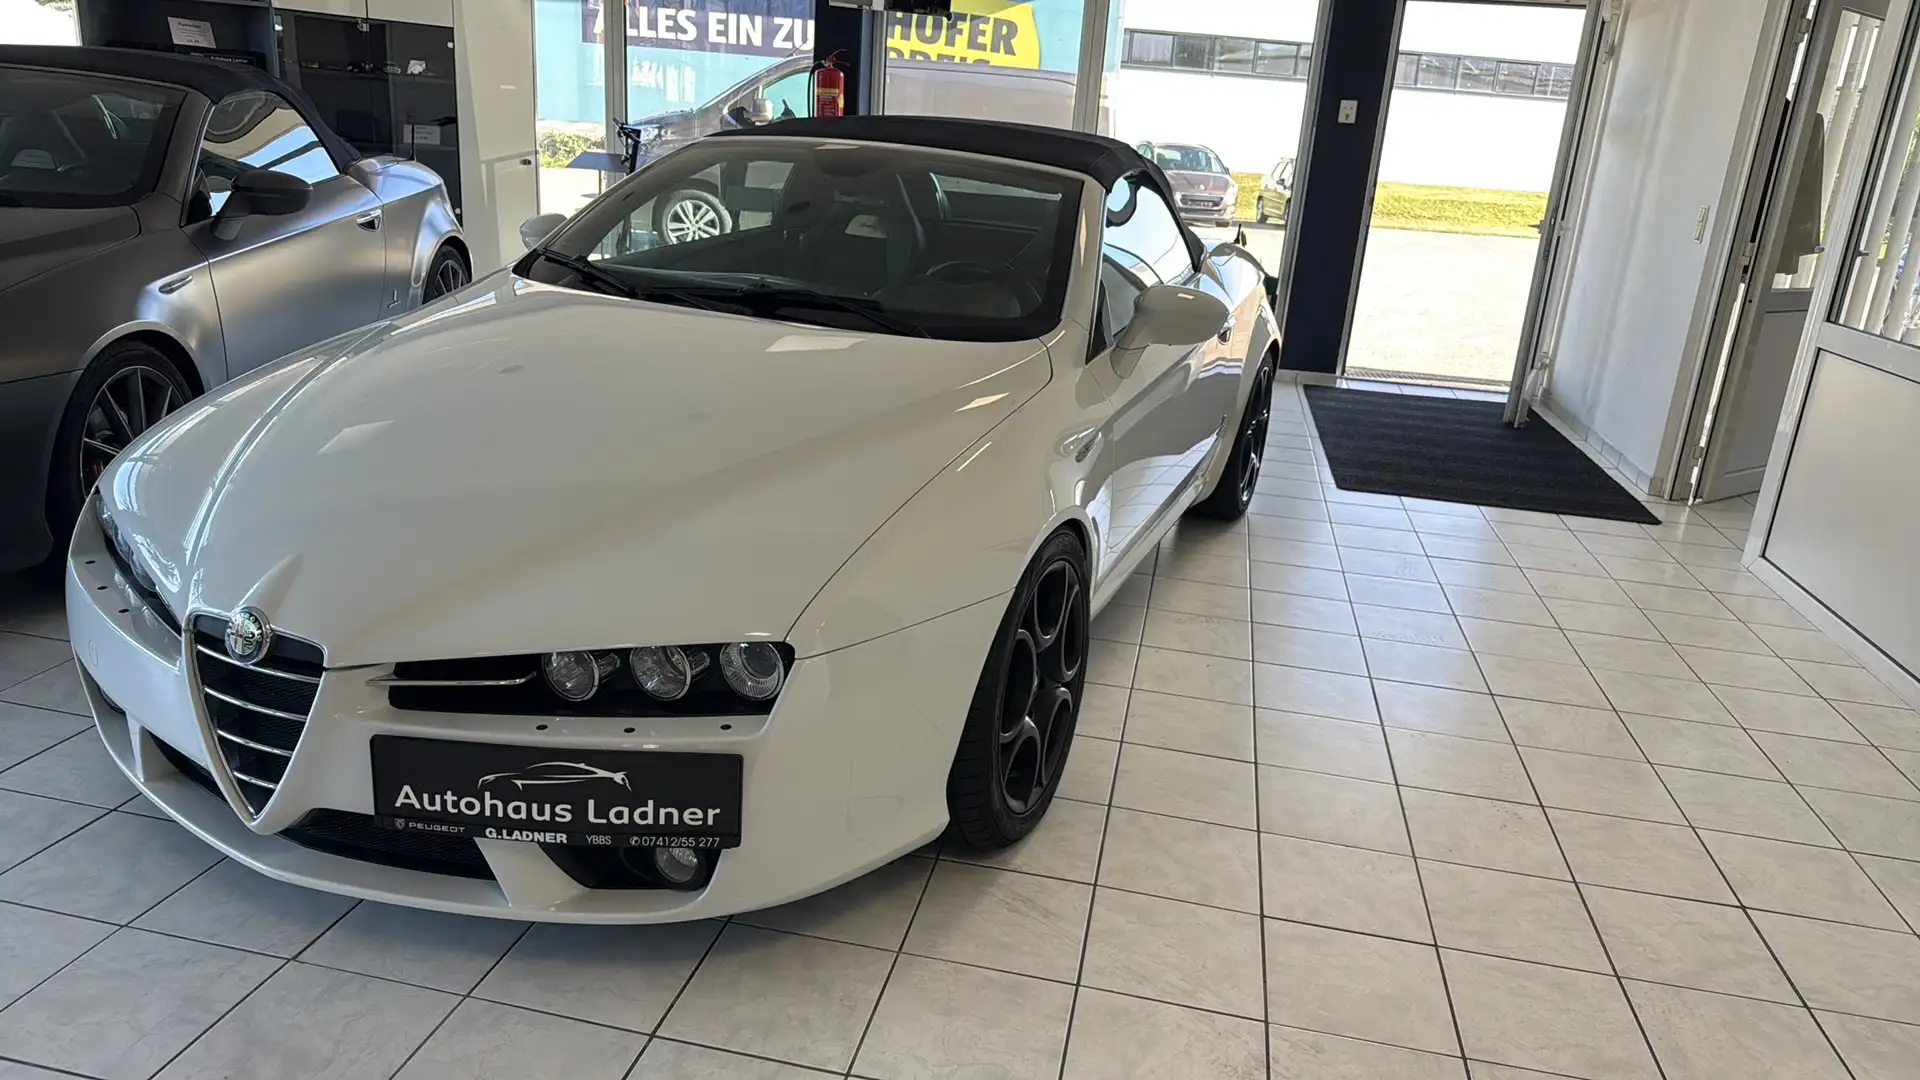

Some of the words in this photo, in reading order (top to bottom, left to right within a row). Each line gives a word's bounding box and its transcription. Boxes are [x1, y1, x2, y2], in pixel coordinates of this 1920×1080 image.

[708, 11, 763, 47] EIN
[887, 12, 1019, 57] HOFER
[394, 784, 573, 823] Autohaus
[587, 798, 721, 826] Ladner
[408, 821, 466, 833] PEUGEOT
[485, 827, 568, 844] G.LADNER
[586, 834, 612, 846] YBBS
[641, 836, 696, 848] 07412/55
[699, 837, 720, 848] 277
